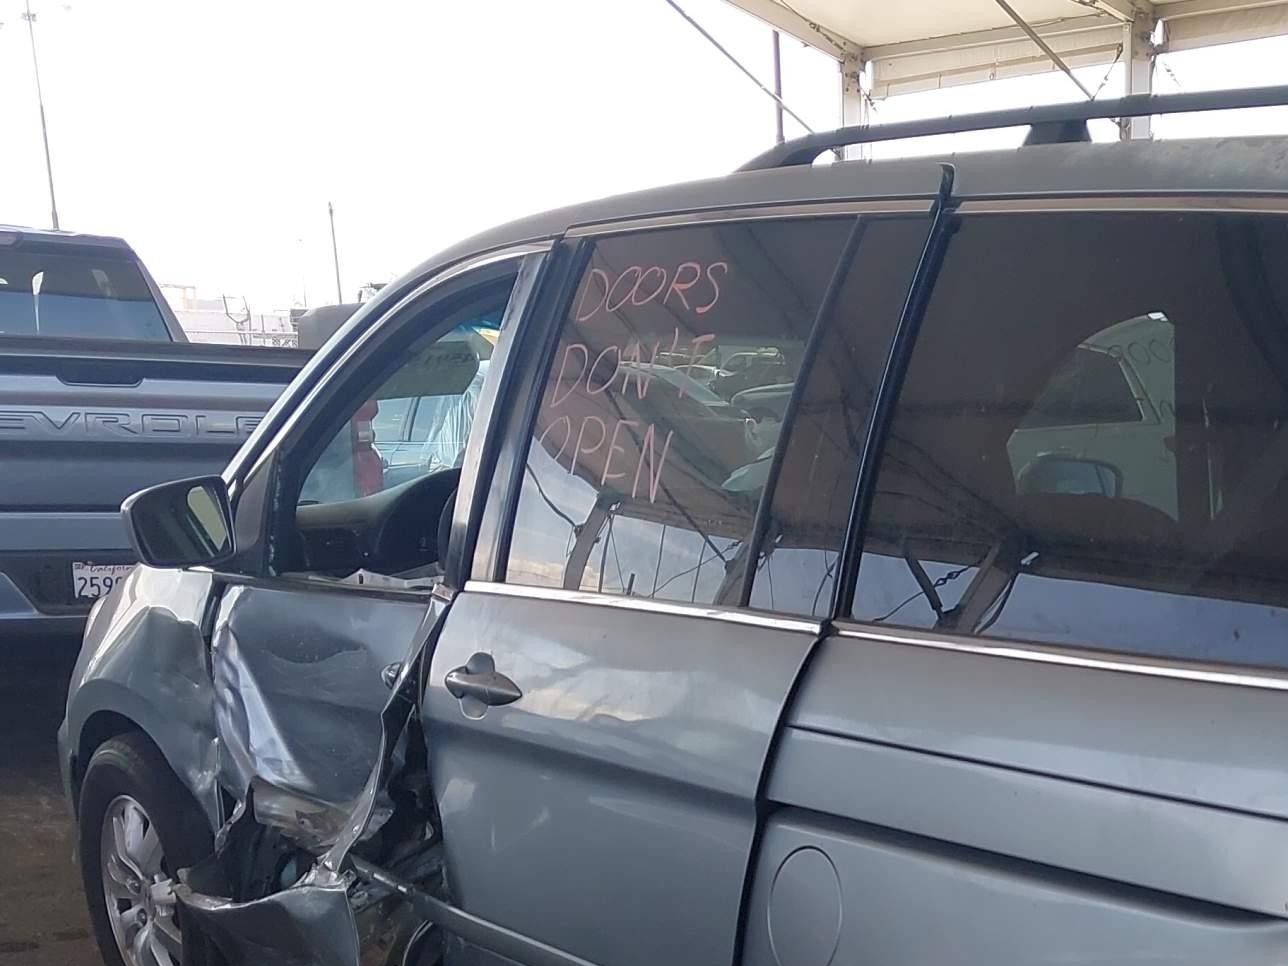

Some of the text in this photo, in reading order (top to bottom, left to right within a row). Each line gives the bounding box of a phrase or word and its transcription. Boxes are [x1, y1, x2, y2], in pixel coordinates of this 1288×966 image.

[575, 261, 728, 321] DOORS
[540, 415, 674, 504] OPEN
[78, 576, 122, 599] 259
